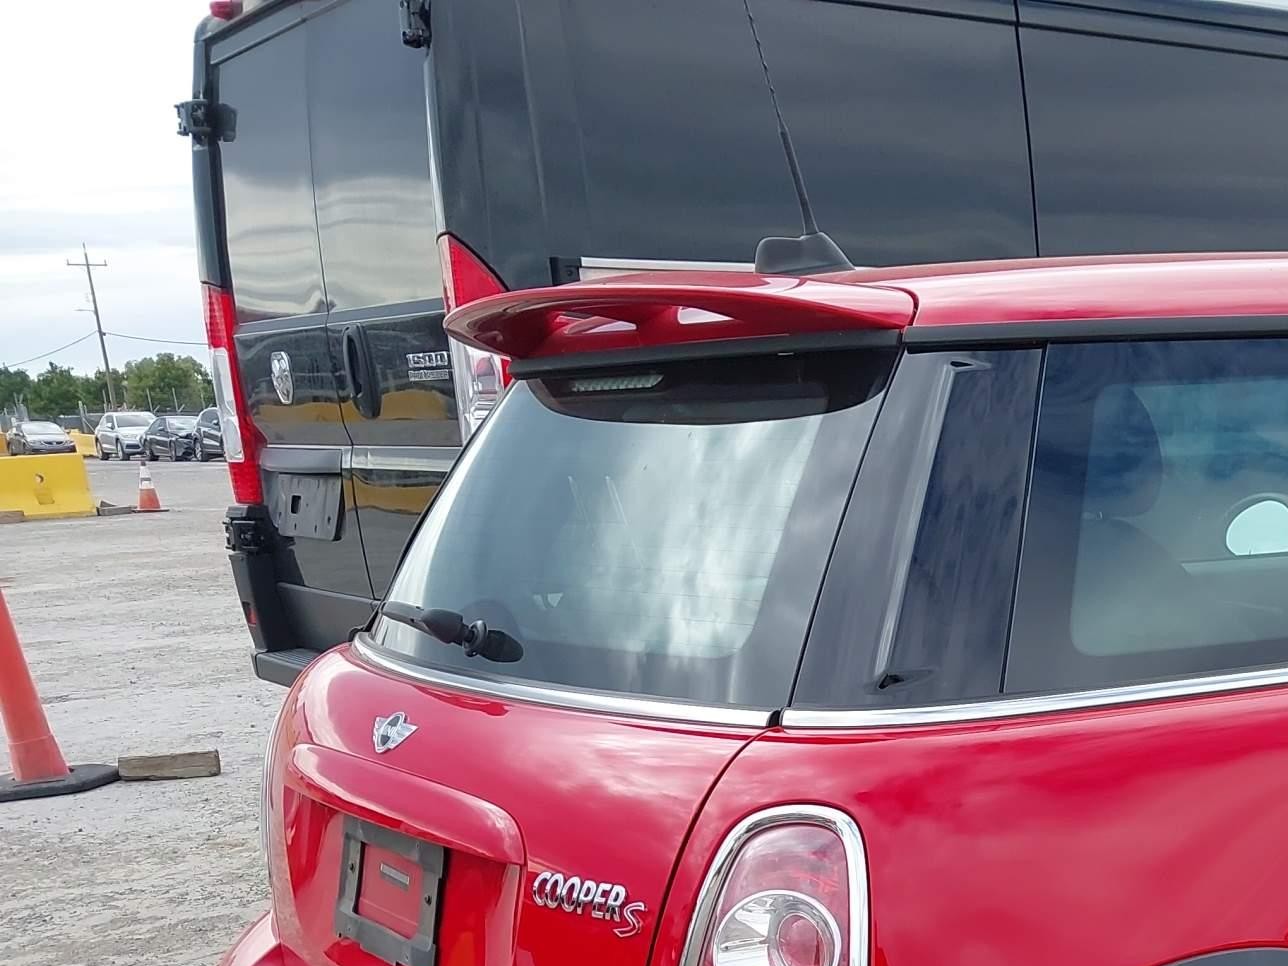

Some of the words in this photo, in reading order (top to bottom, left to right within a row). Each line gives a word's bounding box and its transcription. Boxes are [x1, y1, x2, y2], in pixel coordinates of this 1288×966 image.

[406, 351, 448, 368] 1500
[532, 871, 626, 922] COOPER
[613, 901, 646, 938] S
